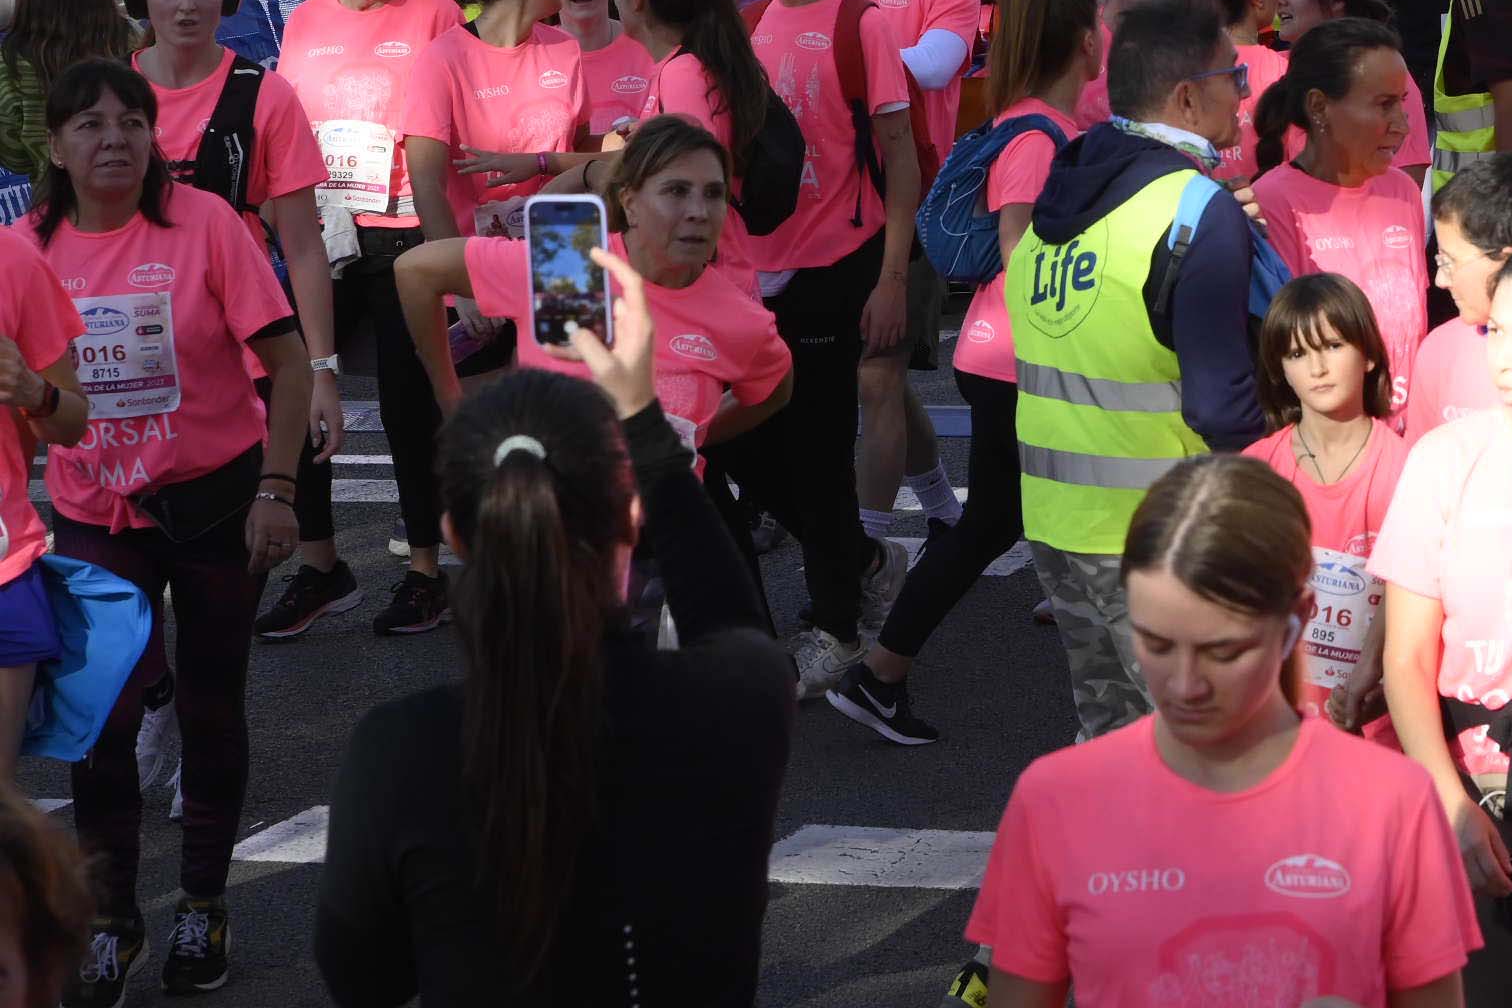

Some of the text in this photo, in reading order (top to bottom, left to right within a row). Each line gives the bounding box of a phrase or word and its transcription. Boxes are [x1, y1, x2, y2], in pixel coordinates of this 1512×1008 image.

[325, 154, 357, 168] 016
[1030, 240, 1097, 312] Life
[84, 319, 126, 329] STURIANA
[82, 345, 127, 363] 016
[92, 368, 120, 379] 8715
[80, 413, 177, 450] ORSAL
[1311, 628, 1335, 643] 895
[1318, 646, 1329, 656] LA
[1088, 867, 1186, 895] OYSHO
